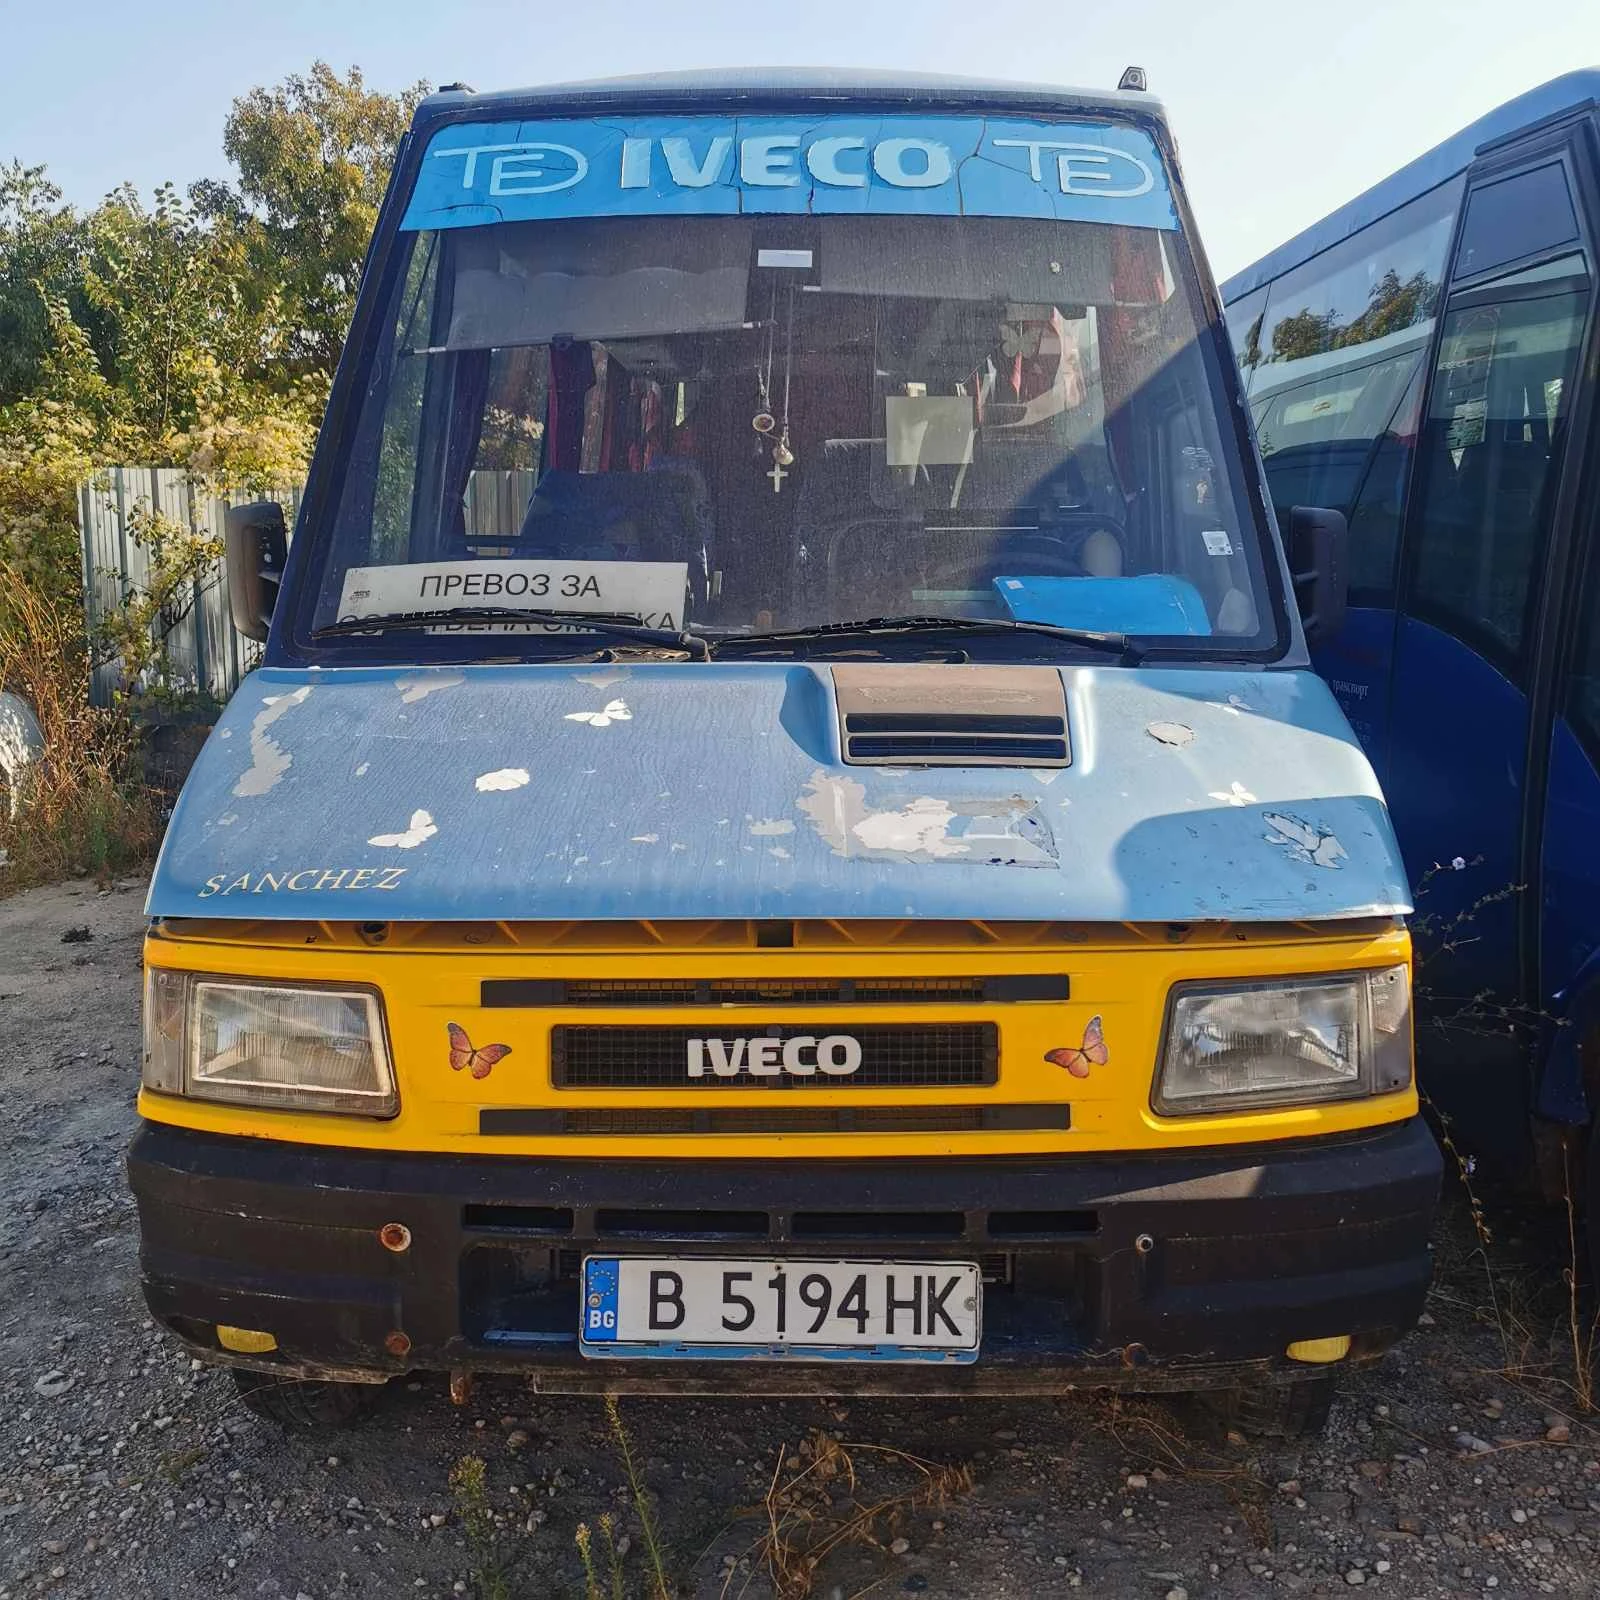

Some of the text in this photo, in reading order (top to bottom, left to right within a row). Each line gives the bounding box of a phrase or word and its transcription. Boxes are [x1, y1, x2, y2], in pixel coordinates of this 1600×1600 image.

[620, 136, 951, 189] IVECO
[419, 574, 601, 598] ПРЕВОЗ ЗА
[198, 868, 407, 898] SANCHEZ
[687, 1035, 862, 1077] IVECO
[589, 1309, 615, 1329] BG
